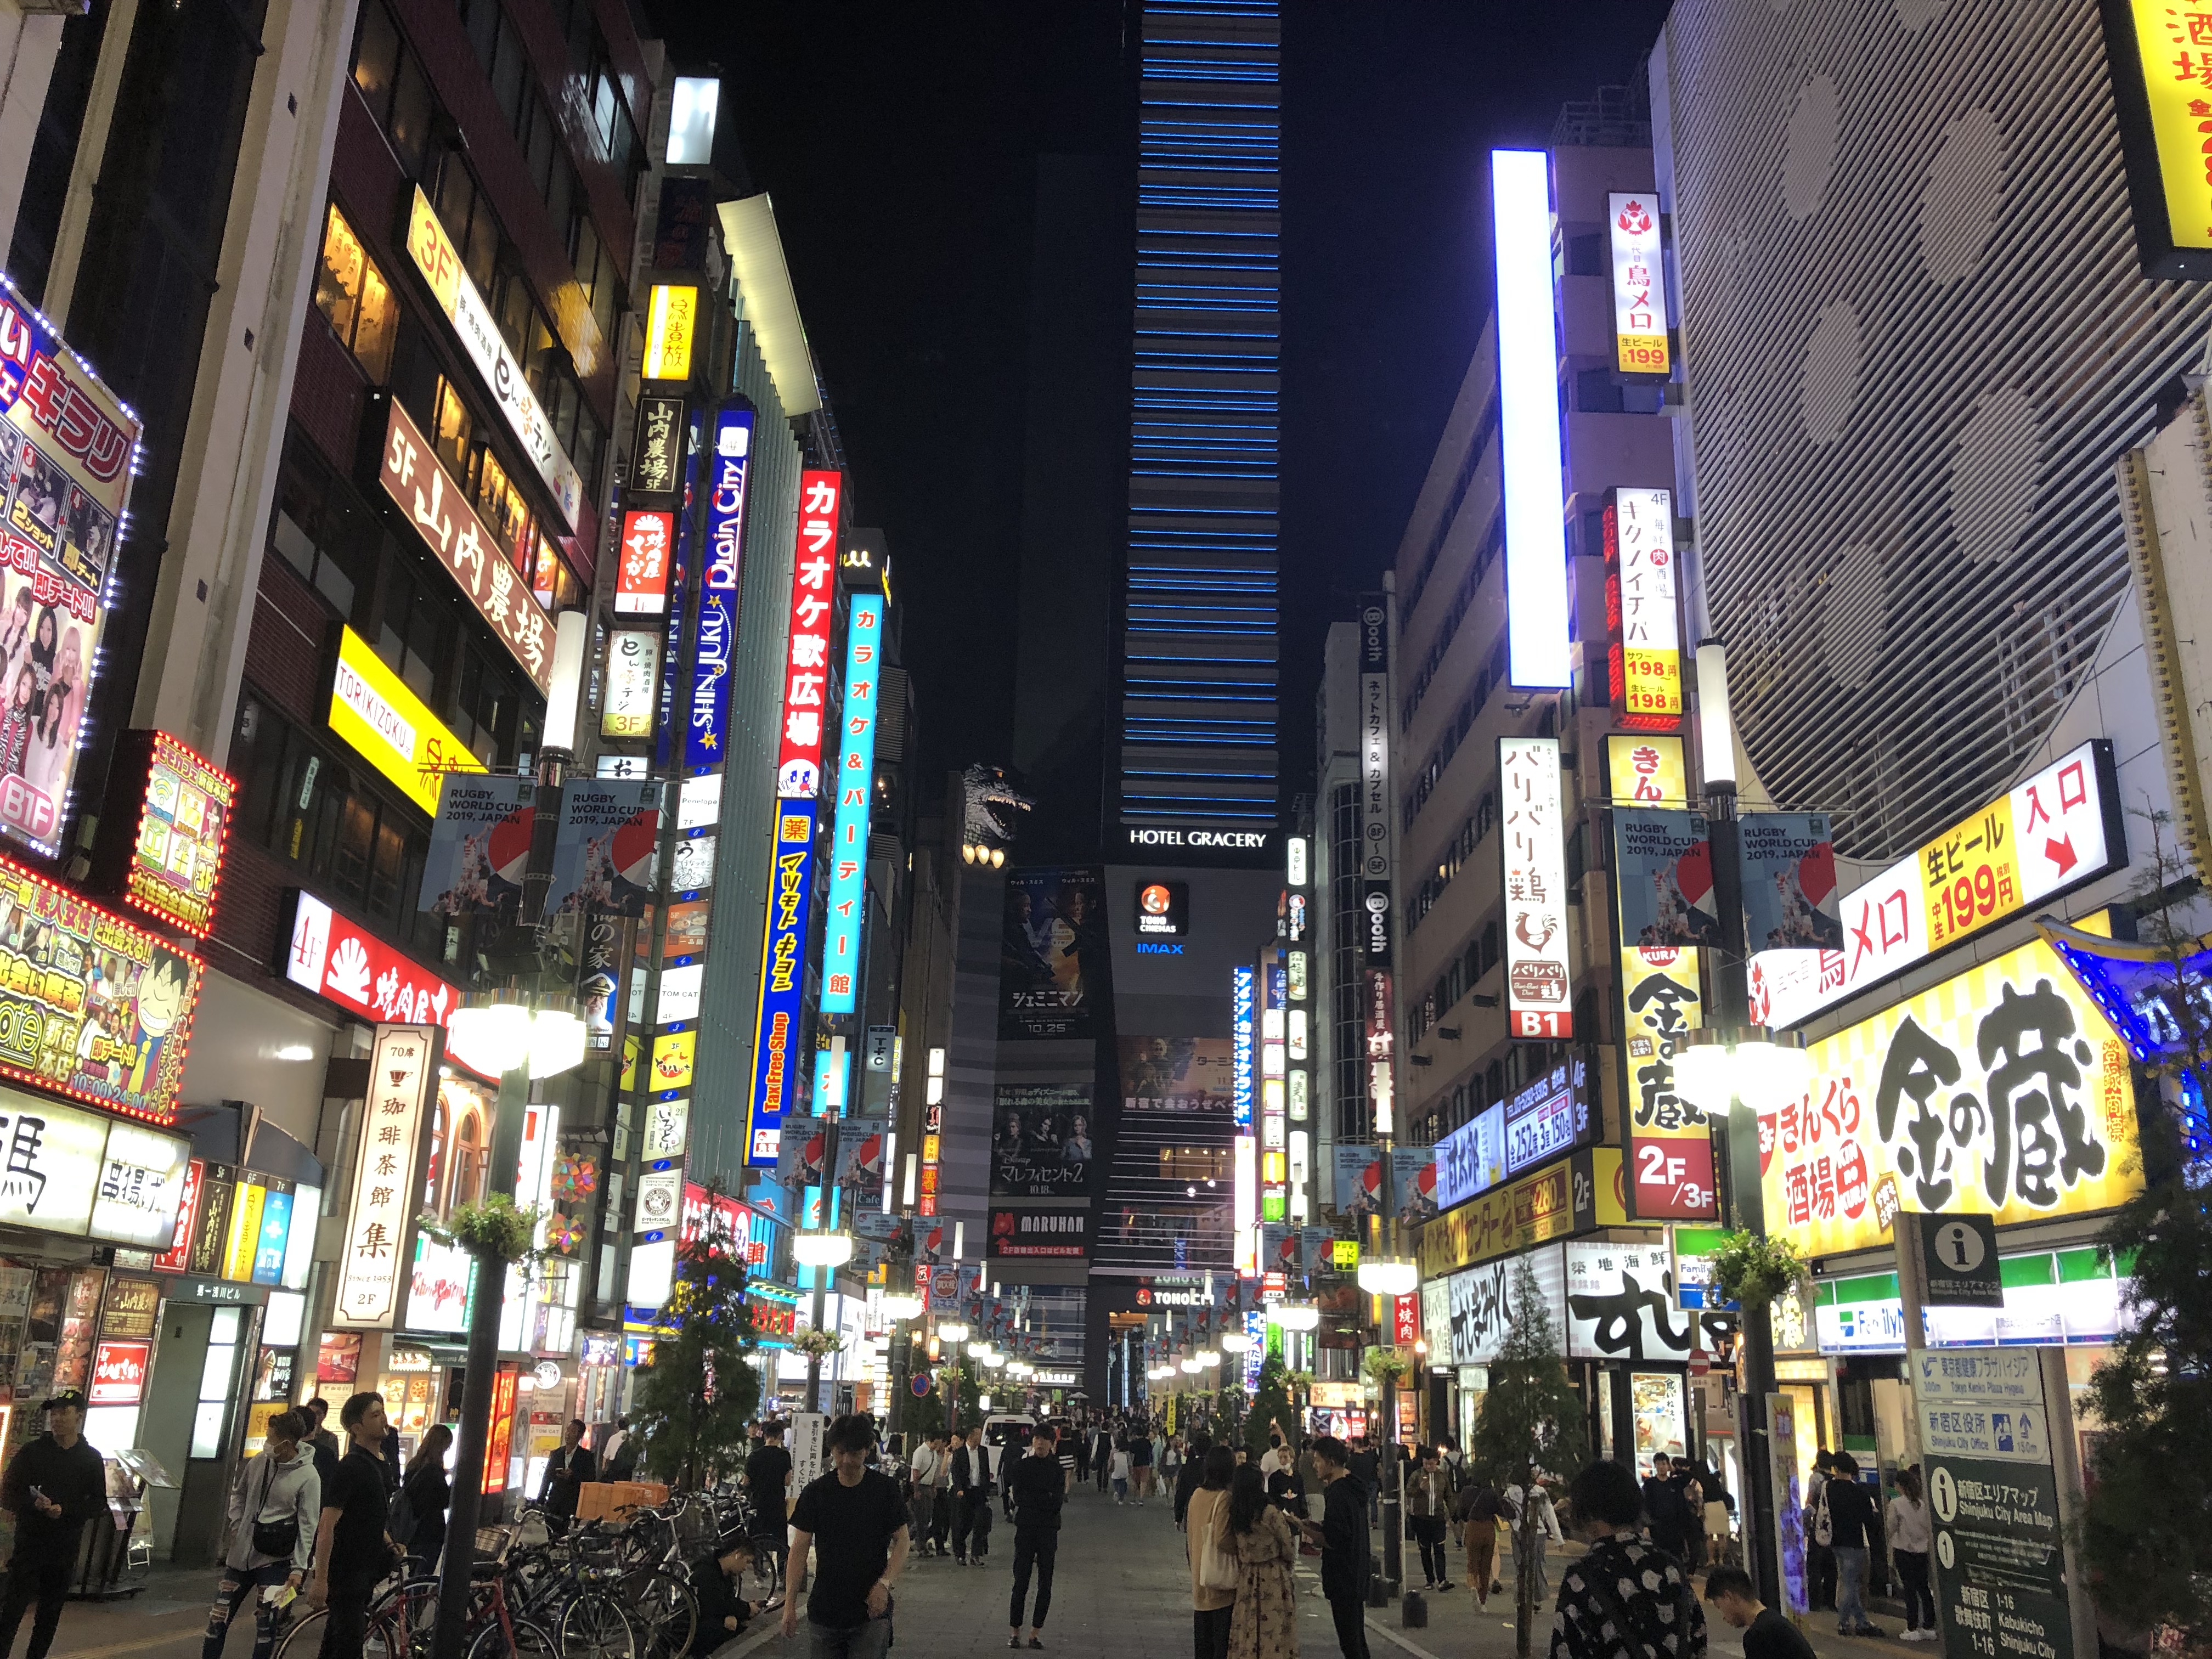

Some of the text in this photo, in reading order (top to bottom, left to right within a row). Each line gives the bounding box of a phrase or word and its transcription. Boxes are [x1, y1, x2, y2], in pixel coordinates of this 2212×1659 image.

[421, 221, 452, 286] 3F
[1627, 265, 1652, 329] 鳥メロ
[1621, 337, 1663, 348] 生ビール
[1627, 348, 1664, 364] 199
[21, 350, 132, 483] キラリ
[640, 402, 673, 479] 山内農場
[388, 426, 417, 486] 5F
[646, 478, 661, 490] 5F
[1651, 493, 1668, 505] 4F
[12, 500, 54, 549] 2ショット
[625, 534, 645, 590] さかい
[643, 531, 666, 578] 焼肉屋
[413, 469, 544, 676] 山内農場
[1622, 501, 1648, 641] キタノイチバ
[32, 569, 96, 624] 即デート!!
[786, 480, 837, 746] カラオケ歌広場
[1363, 606, 1385, 662] Booth
[693, 610, 725, 727] SHINJUKU
[1627, 661, 1664, 676] 198
[1631, 684, 1664, 692] 生ビール
[338, 665, 407, 747] TORIKIZOKU
[1629, 693, 1666, 709] 198
[615, 716, 641, 731] 3F
[1369, 680, 1382, 814] ネットカフェ & カプセル
[1632, 746, 1662, 801] きん
[449, 800, 523, 812] WORLD CUP
[450, 789, 493, 799] RUGBY
[573, 793, 616, 804] RUGBY
[829, 611, 876, 995] カラオケ&パーティー館
[2025, 759, 2086, 834] 入口
[3, 786, 53, 837] B1F
[446, 811, 521, 824] 2019, JAPAN
[569, 816, 643, 827] 2019, JAPAN
[571, 804, 646, 815] WORLD CUP
[783, 818, 809, 842] 薬
[1130, 830, 1266, 847] HOTEL GRACERY
[1625, 823, 1668, 834] RUGBY
[1626, 834, 1699, 847] WORLD CUP
[1744, 828, 1786, 838] RUGBY
[1627, 846, 1701, 857] 2019, JAPAN
[1745, 838, 1818, 849] WORLD CUP
[1747, 850, 1821, 861] 2019, JAPAN
[1926, 812, 2004, 889] 生ビール
[194, 861, 215, 896] 3F
[1932, 864, 2014, 942] 中生 199 円
[771, 851, 807, 992] マツモトキヨシ
[1140, 916, 1166, 925] TOHO
[1140, 924, 1176, 933] CINEMAS
[1366, 892, 1389, 953] Booth
[292, 916, 323, 969] 4F
[1136, 943, 1183, 955] IMAX
[1642, 950, 1678, 962] KURA
[1513, 962, 1565, 979] バリバリ
[1013, 990, 1084, 1008] ジェミニマン
[1028, 1024, 1066, 1033] 10.25
[1521, 1012, 1559, 1037] B1
[390, 1046, 415, 1058] 70席
[764, 1012, 789, 1113] Tax Free Shop
[1238, 1020, 1251, 1119] カラオケランド
[1573, 1060, 1586, 1088] 4F
[1876, 978, 2106, 1213] 金の蔵
[2102, 1039, 2125, 1143] 登録商標
[675, 1108, 685, 1116] 2F
[1575, 1102, 1589, 1132] 3F
[1780, 1077, 1860, 1153] きんくら
[1758, 1120, 1775, 1154] 3F
[216, 1165, 226, 1178] 5F
[247, 1172, 257, 1184] 6F
[356, 1097, 407, 1259] 珈琲茶館 集
[1000, 1163, 1083, 1183] マレフィセント2
[1638, 1146, 1686, 1185] 2F
[276, 1180, 286, 1192] 7F
[858, 1192, 880, 1205] Cafe
[1029, 1185, 1049, 1194] 10.18
[1575, 1171, 1590, 1212] 2F
[1785, 1156, 1836, 1226] 酒場
[1021, 1216, 1084, 1232] MARUHAN
[1571, 1252, 1666, 1276] 築地海鮮
[373, 1275, 392, 1284] 1953
[357, 1293, 377, 1305] 2F
[1154, 1292, 1190, 1305] TOHO
[1398, 1309, 1414, 1340] 焼肉
[1929, 1411, 1986, 1434] 新宿区役所
[1931, 1435, 1989, 1451] Shinjuku City Office
[1957, 1479, 2039, 1508] 新宿区エリアマップ
[1959, 1500, 2053, 1531] Shinjuku City Area Map
[1960, 1584, 2015, 1611] 新宿区 1-16
[1954, 1604, 2045, 1638] 歌舞伎町 Kabukicho
[1971, 1632, 2056, 1659] 1-16 Shinjuku City
